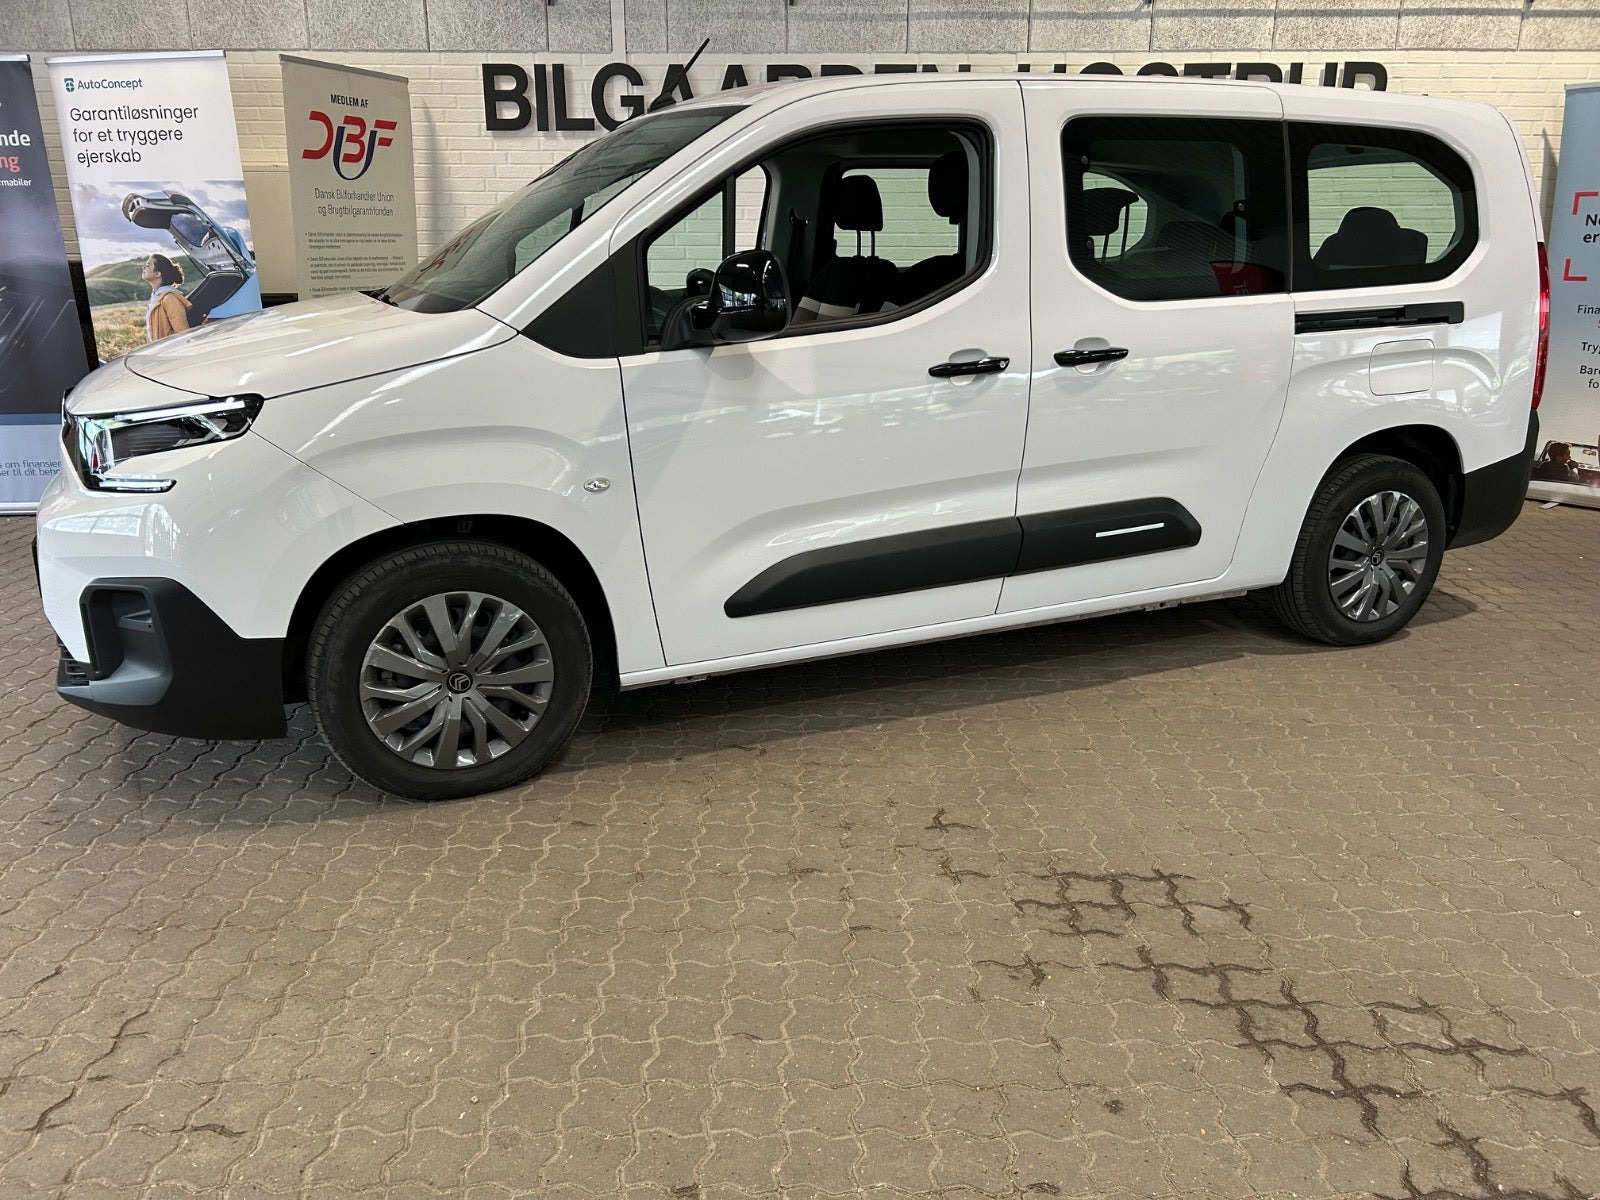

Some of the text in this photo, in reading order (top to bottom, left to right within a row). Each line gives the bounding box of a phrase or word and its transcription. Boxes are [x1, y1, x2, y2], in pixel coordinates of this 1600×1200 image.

[77, 78, 143, 90] AutoConcept
[330, 93, 369, 108] MEDLEM AF
[70, 105, 199, 123] Garantiløsninger
[73, 128, 183, 146] for et tryggere
[77, 148, 142, 167] ejerskab
[314, 187, 395, 203] Dansk Bilforhandler Union
[318, 203, 394, 218] og Brugtbilgarantifonden
[1586, 213, 1600, 227] N
[12, 468, 21, 477] til
[25, 467, 36, 477] dit
